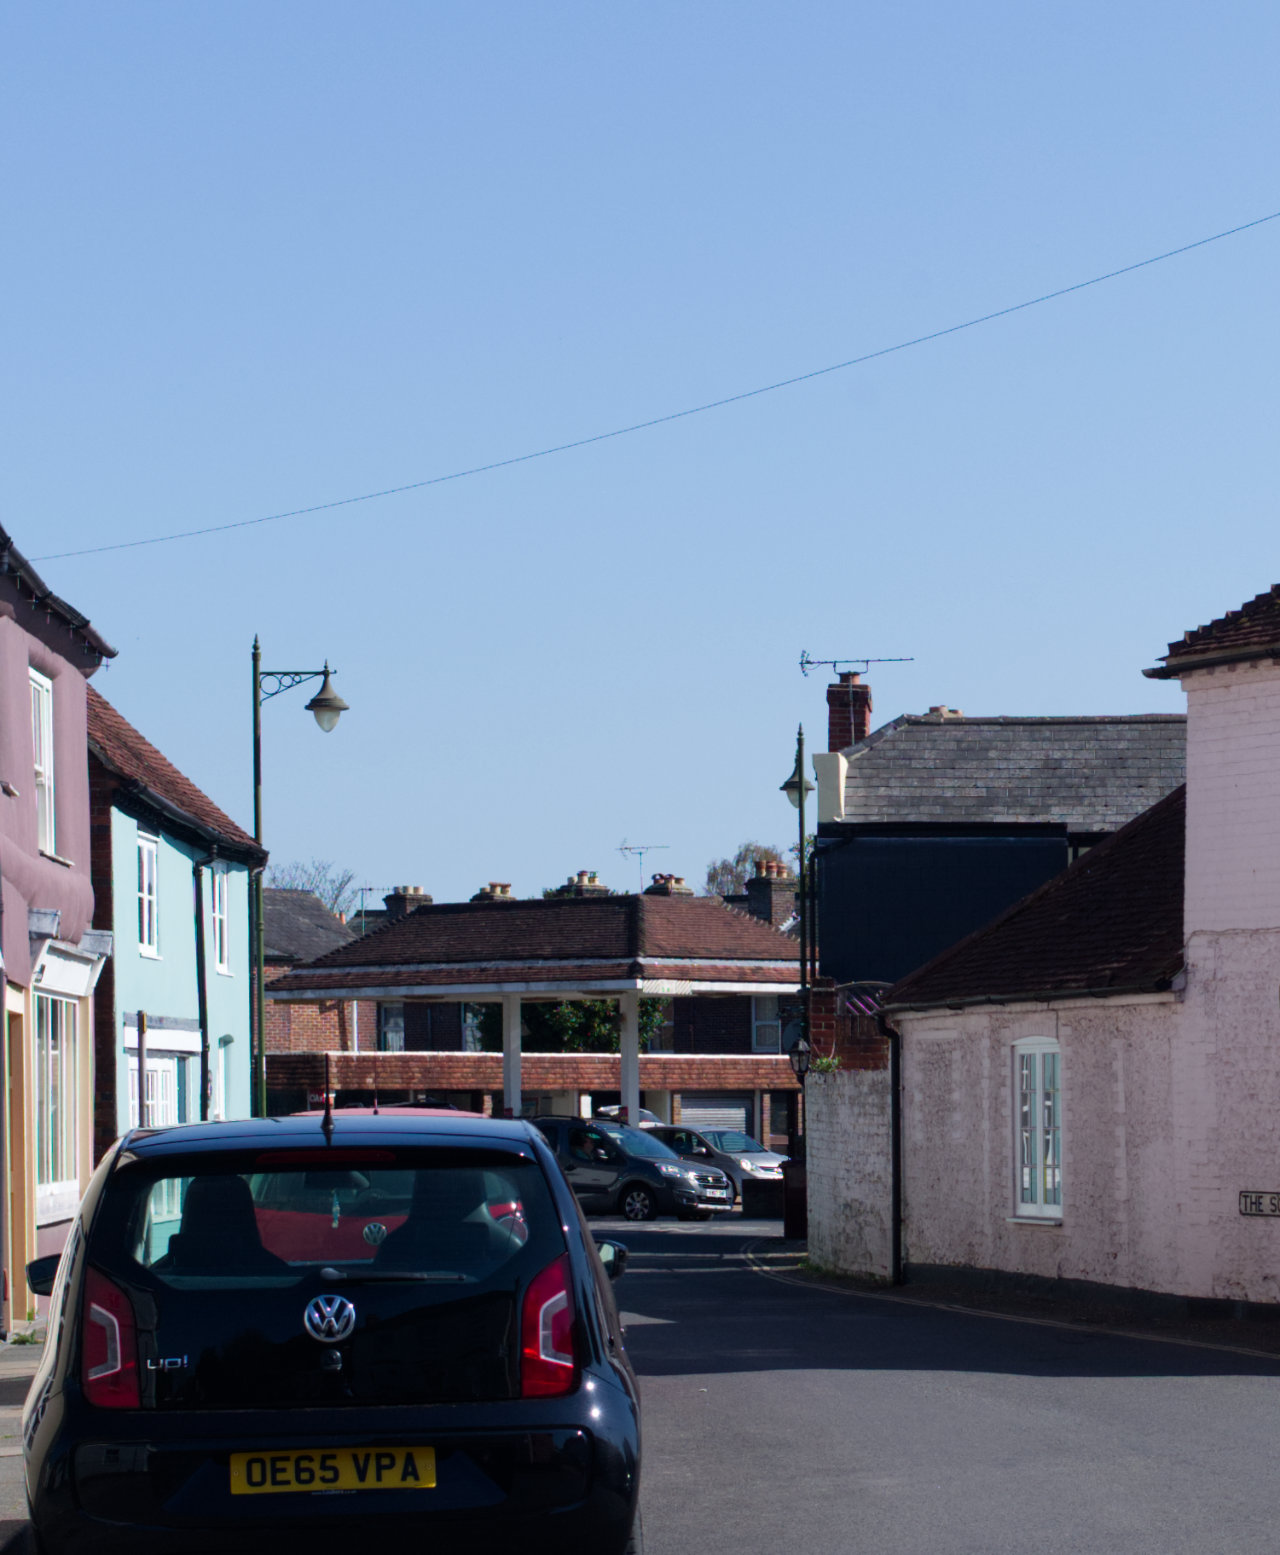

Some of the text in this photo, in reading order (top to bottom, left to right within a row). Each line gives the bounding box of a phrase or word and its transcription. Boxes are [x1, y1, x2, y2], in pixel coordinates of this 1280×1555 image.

[1241, 1194, 1264, 1213] THE
[146, 1354, 189, 1373] up!
[245, 1451, 421, 1487] OE65 VPA
